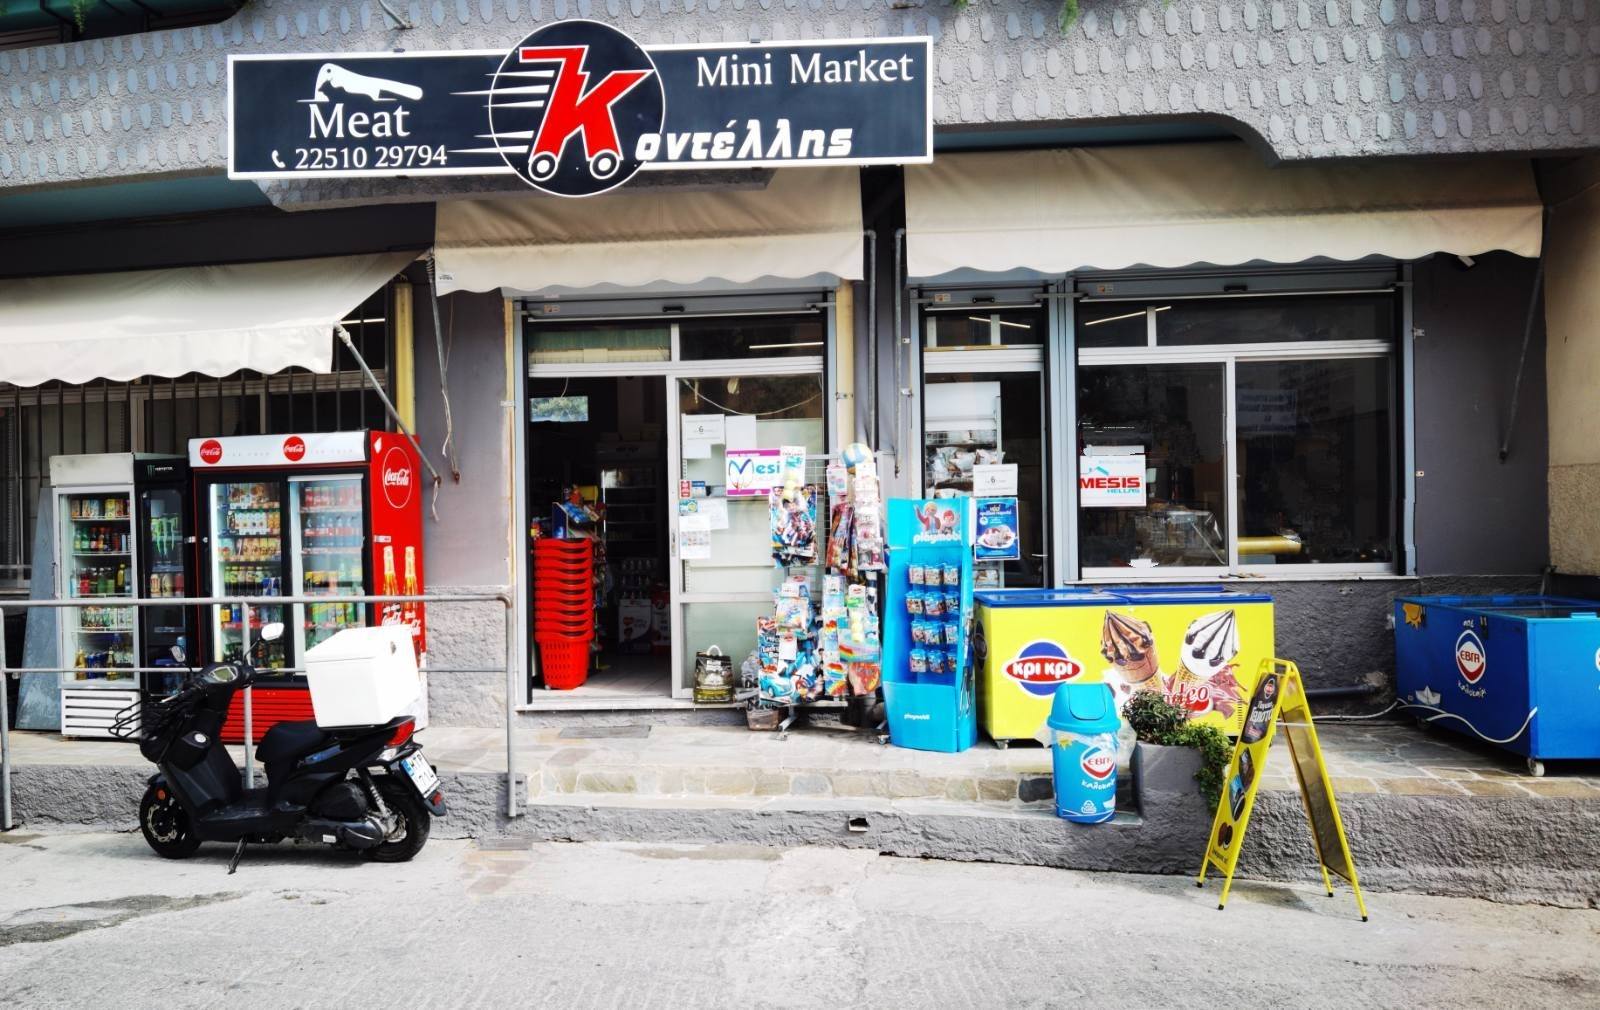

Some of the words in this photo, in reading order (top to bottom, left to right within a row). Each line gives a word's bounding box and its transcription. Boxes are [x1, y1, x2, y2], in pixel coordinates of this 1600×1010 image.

[697, 54, 773, 87] Mini
[790, 48, 914, 84] Market
[308, 103, 411, 139] Meat
[295, 147, 367, 169] 22510
[375, 144, 447, 167] 29794
[1080, 477, 1141, 489] MESIS
